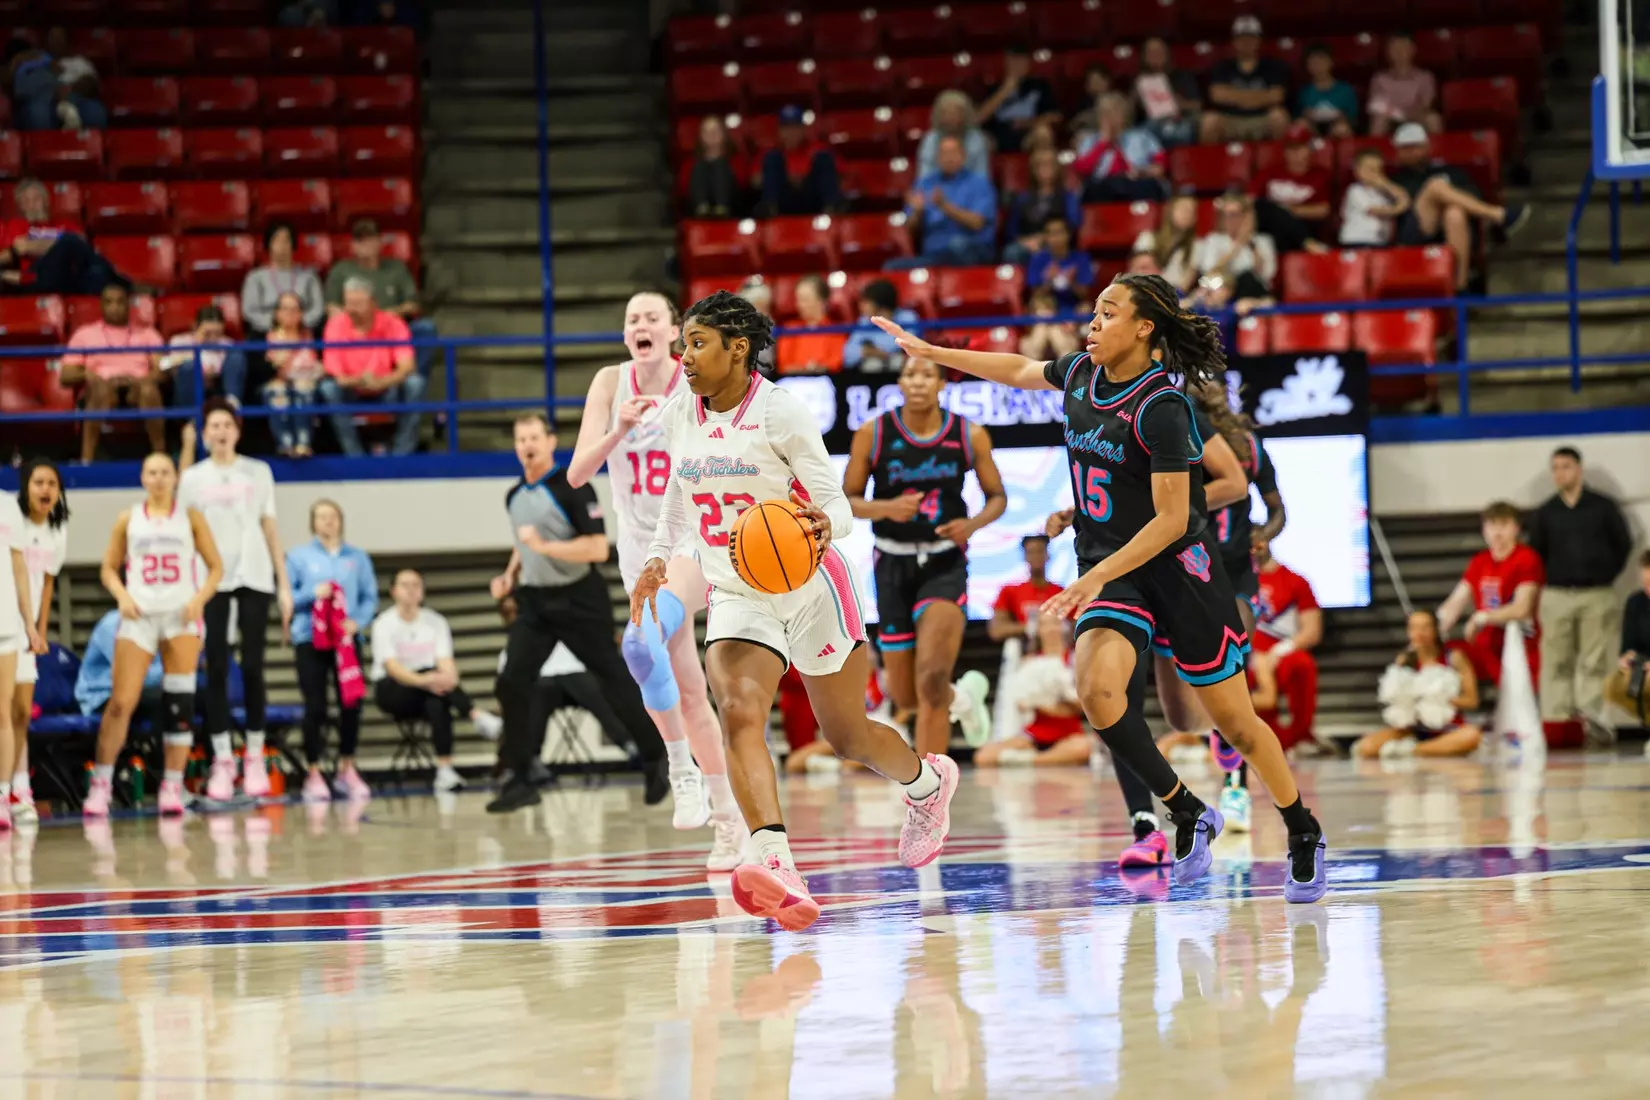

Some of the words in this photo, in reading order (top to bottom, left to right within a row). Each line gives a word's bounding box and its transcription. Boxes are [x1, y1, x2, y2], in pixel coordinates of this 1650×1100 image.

[626, 450, 671, 496] 18
[677, 457, 701, 485] Lady
[702, 456, 760, 478] Techsters
[1072, 460, 1113, 523] 15
[142, 554, 181, 584] 25
